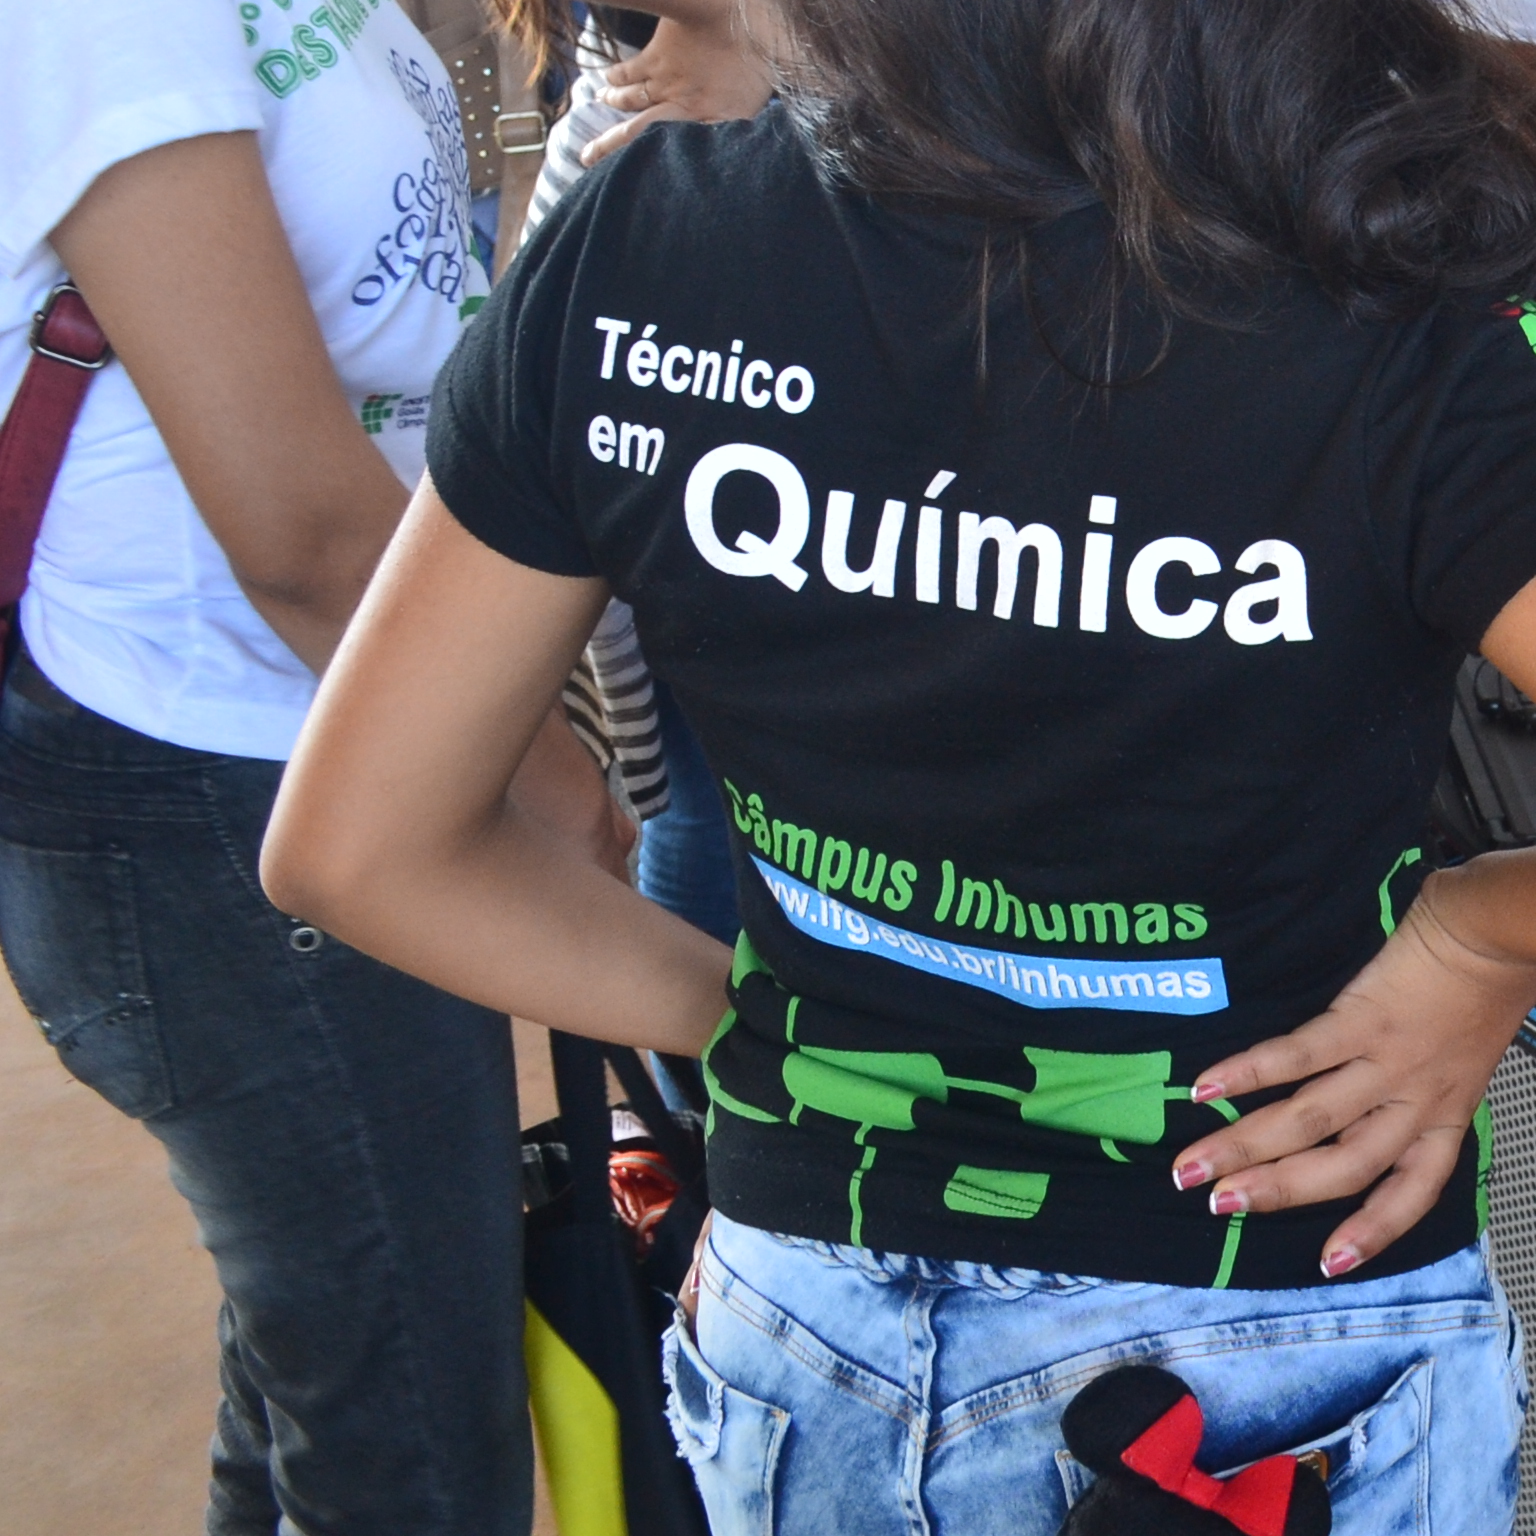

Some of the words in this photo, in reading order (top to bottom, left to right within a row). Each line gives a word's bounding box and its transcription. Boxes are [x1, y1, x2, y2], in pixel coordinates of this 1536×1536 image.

[594, 316, 816, 414] Técnico
[587, 414, 665, 476] em
[683, 442, 1314, 646] Química
[724, 777, 917, 911] Câmpus
[934, 859, 1208, 945] Inhumas
